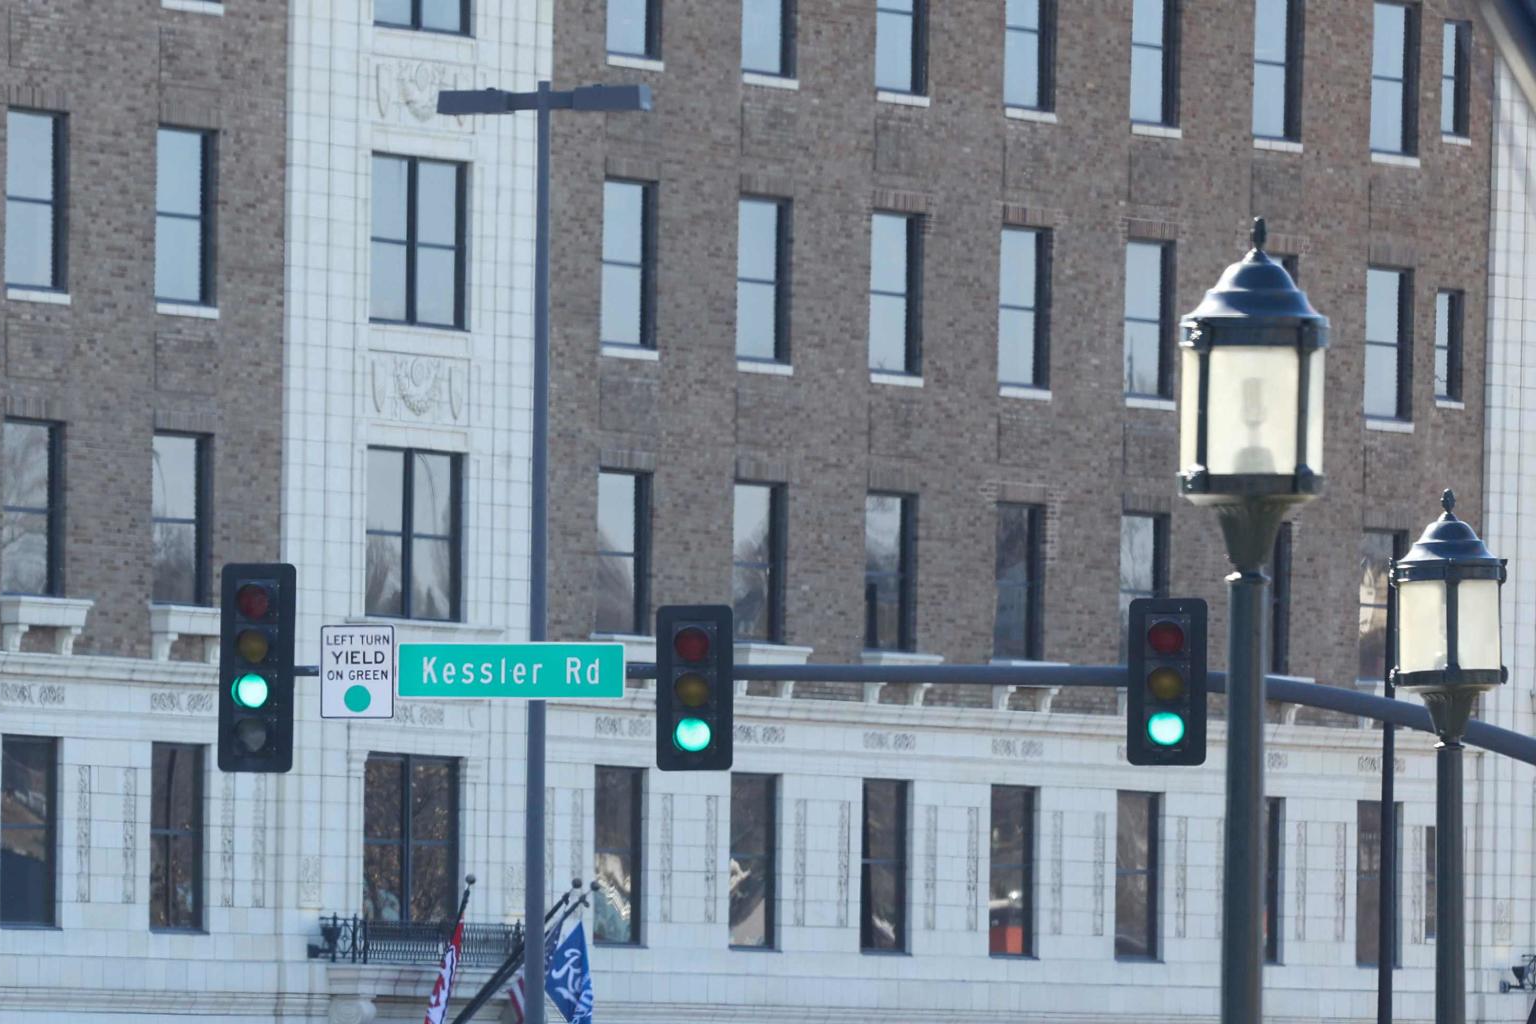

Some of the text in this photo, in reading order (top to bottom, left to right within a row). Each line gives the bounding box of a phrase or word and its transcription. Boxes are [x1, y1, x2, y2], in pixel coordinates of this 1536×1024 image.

[326, 634, 390, 646] LEFT TURN
[332, 651, 385, 665] YIELD
[327, 669, 389, 681] ON GREEN
[422, 656, 600, 684] Kessler Rd
